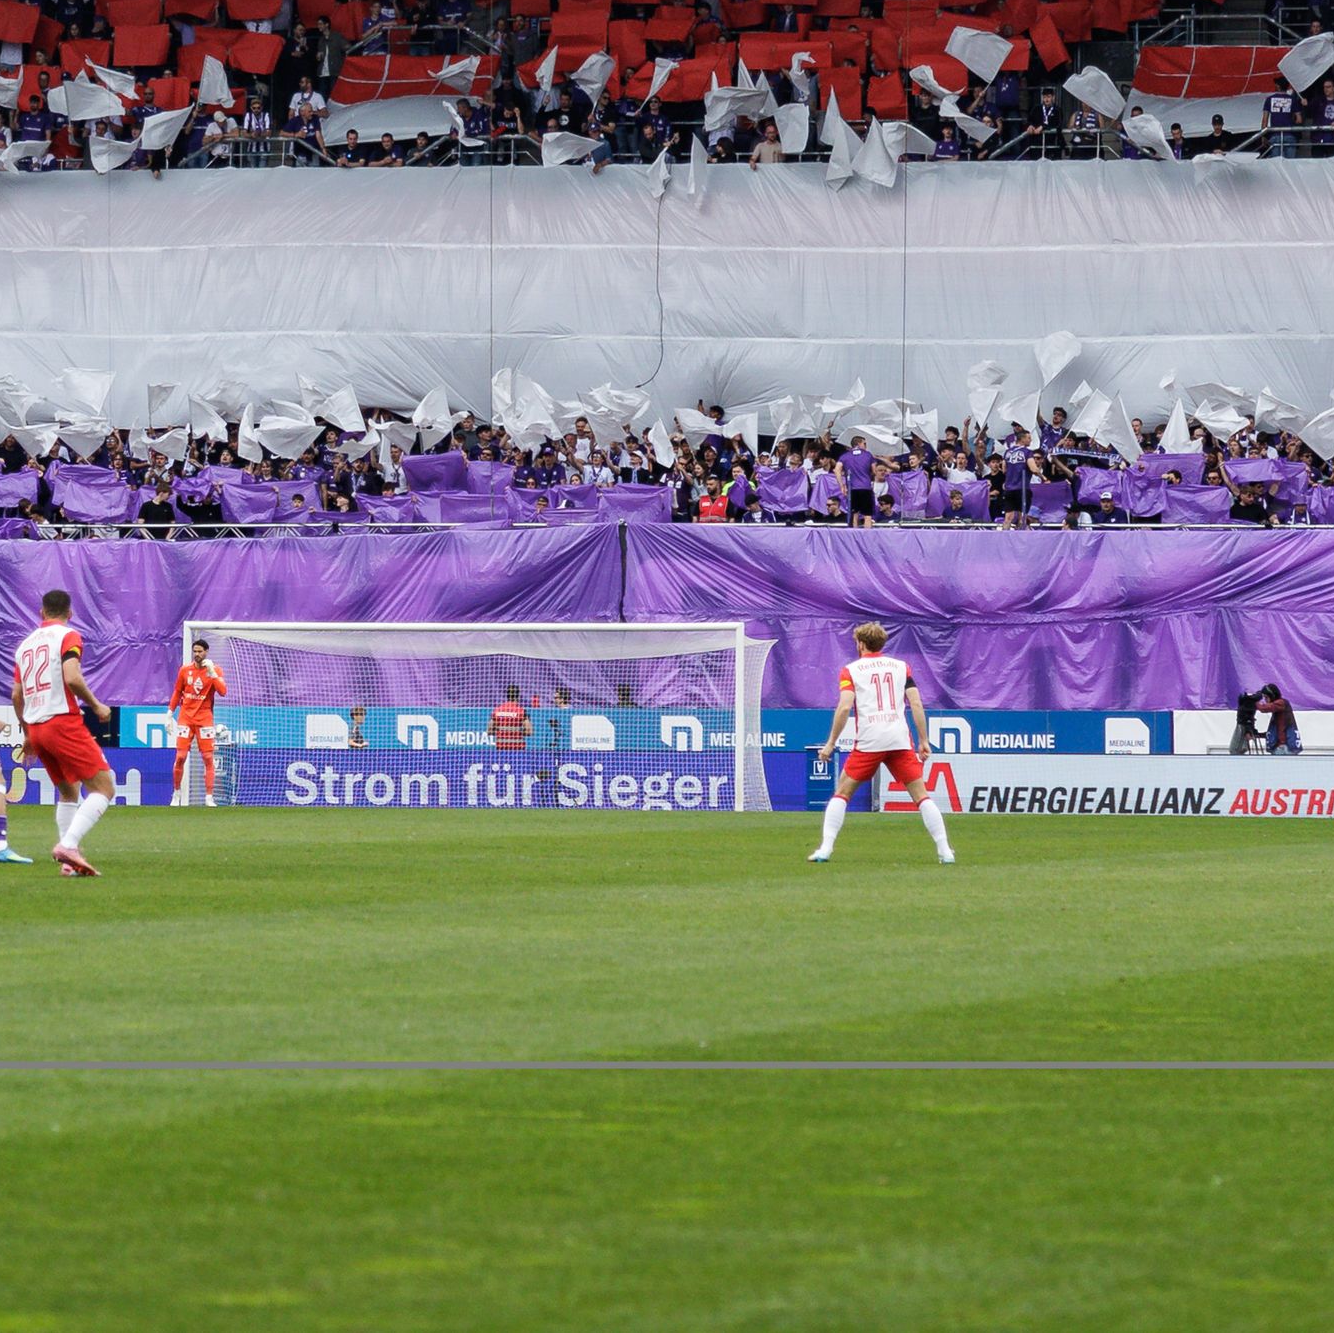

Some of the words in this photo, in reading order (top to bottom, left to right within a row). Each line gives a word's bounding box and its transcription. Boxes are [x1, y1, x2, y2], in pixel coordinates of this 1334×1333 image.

[22, 644, 51, 696] 22
[870, 672, 896, 711] 11
[979, 734, 1055, 748] MEDIALINE
[1109, 739, 1146, 747] MEDIALINE
[285, 761, 448, 805] Strom
[463, 763, 539, 805] für
[558, 763, 728, 810] Sieger
[969, 786, 1224, 814] ENERGIEALLIANZ
